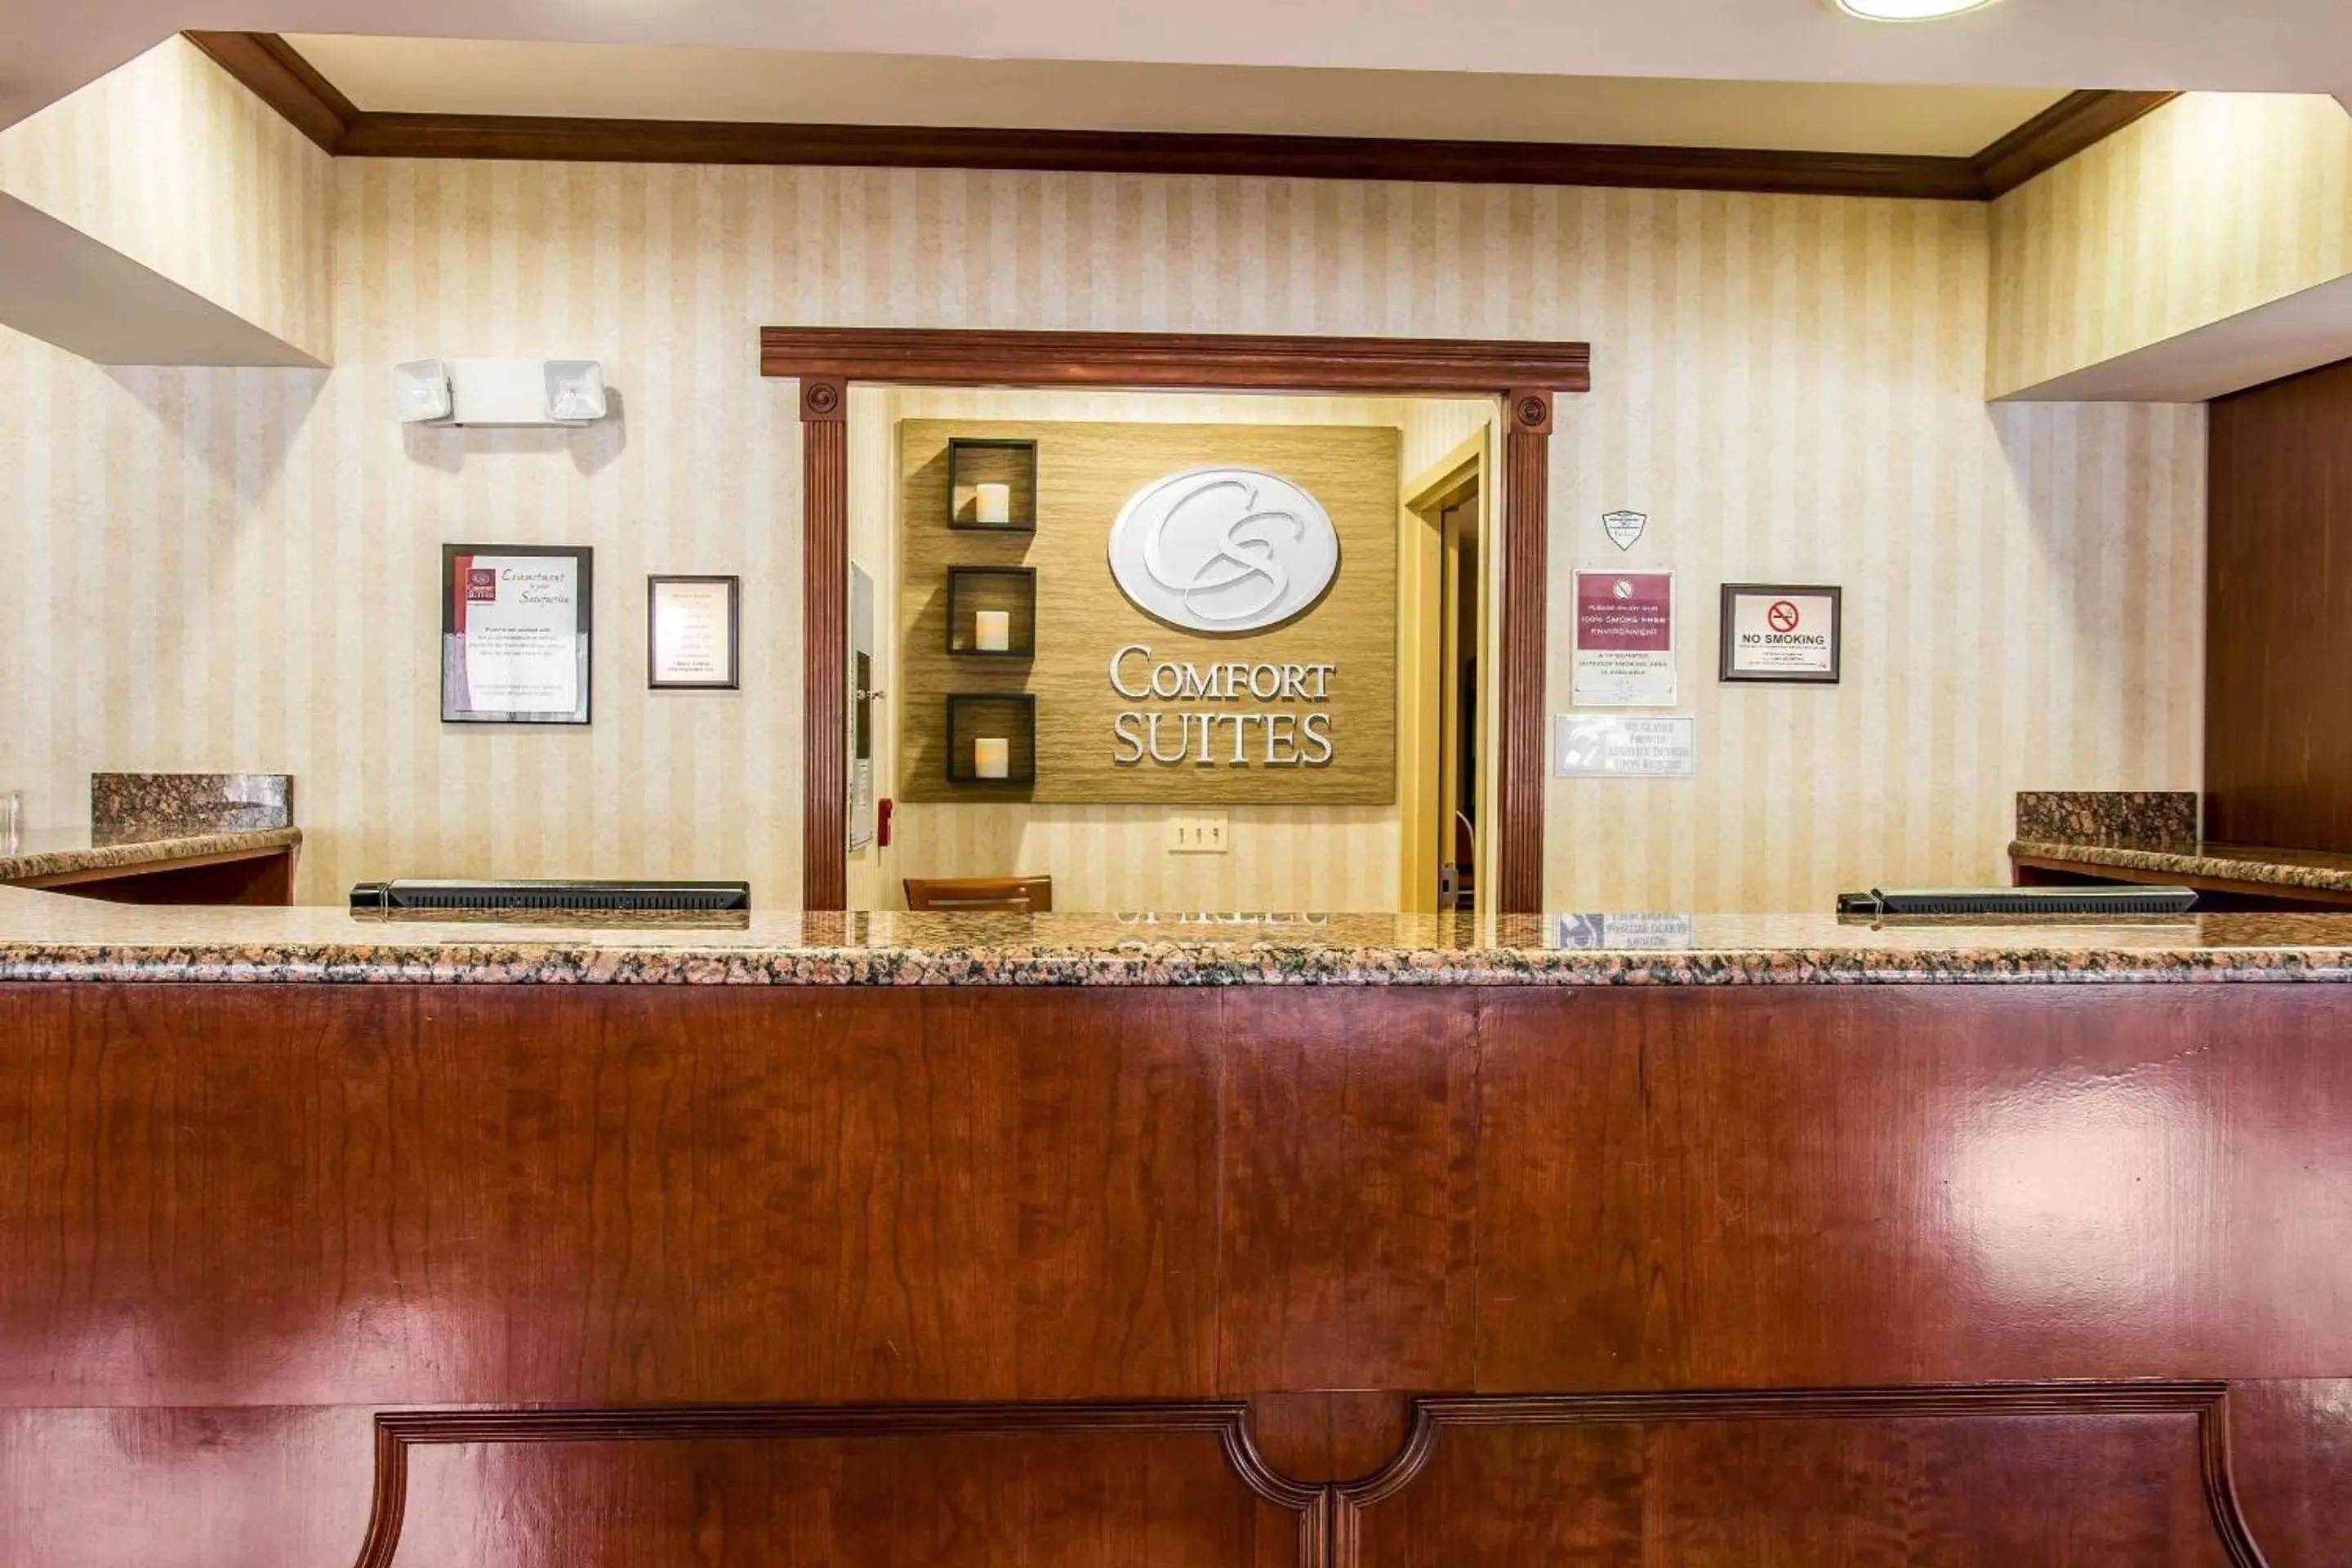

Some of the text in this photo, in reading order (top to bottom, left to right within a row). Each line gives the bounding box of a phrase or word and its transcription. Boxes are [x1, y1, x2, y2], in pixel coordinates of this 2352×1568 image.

[1742, 635, 1825, 645] NO SMOKING
[1110, 644, 1337, 702] COMFORT
[1112, 711, 1334, 768] SUITES
